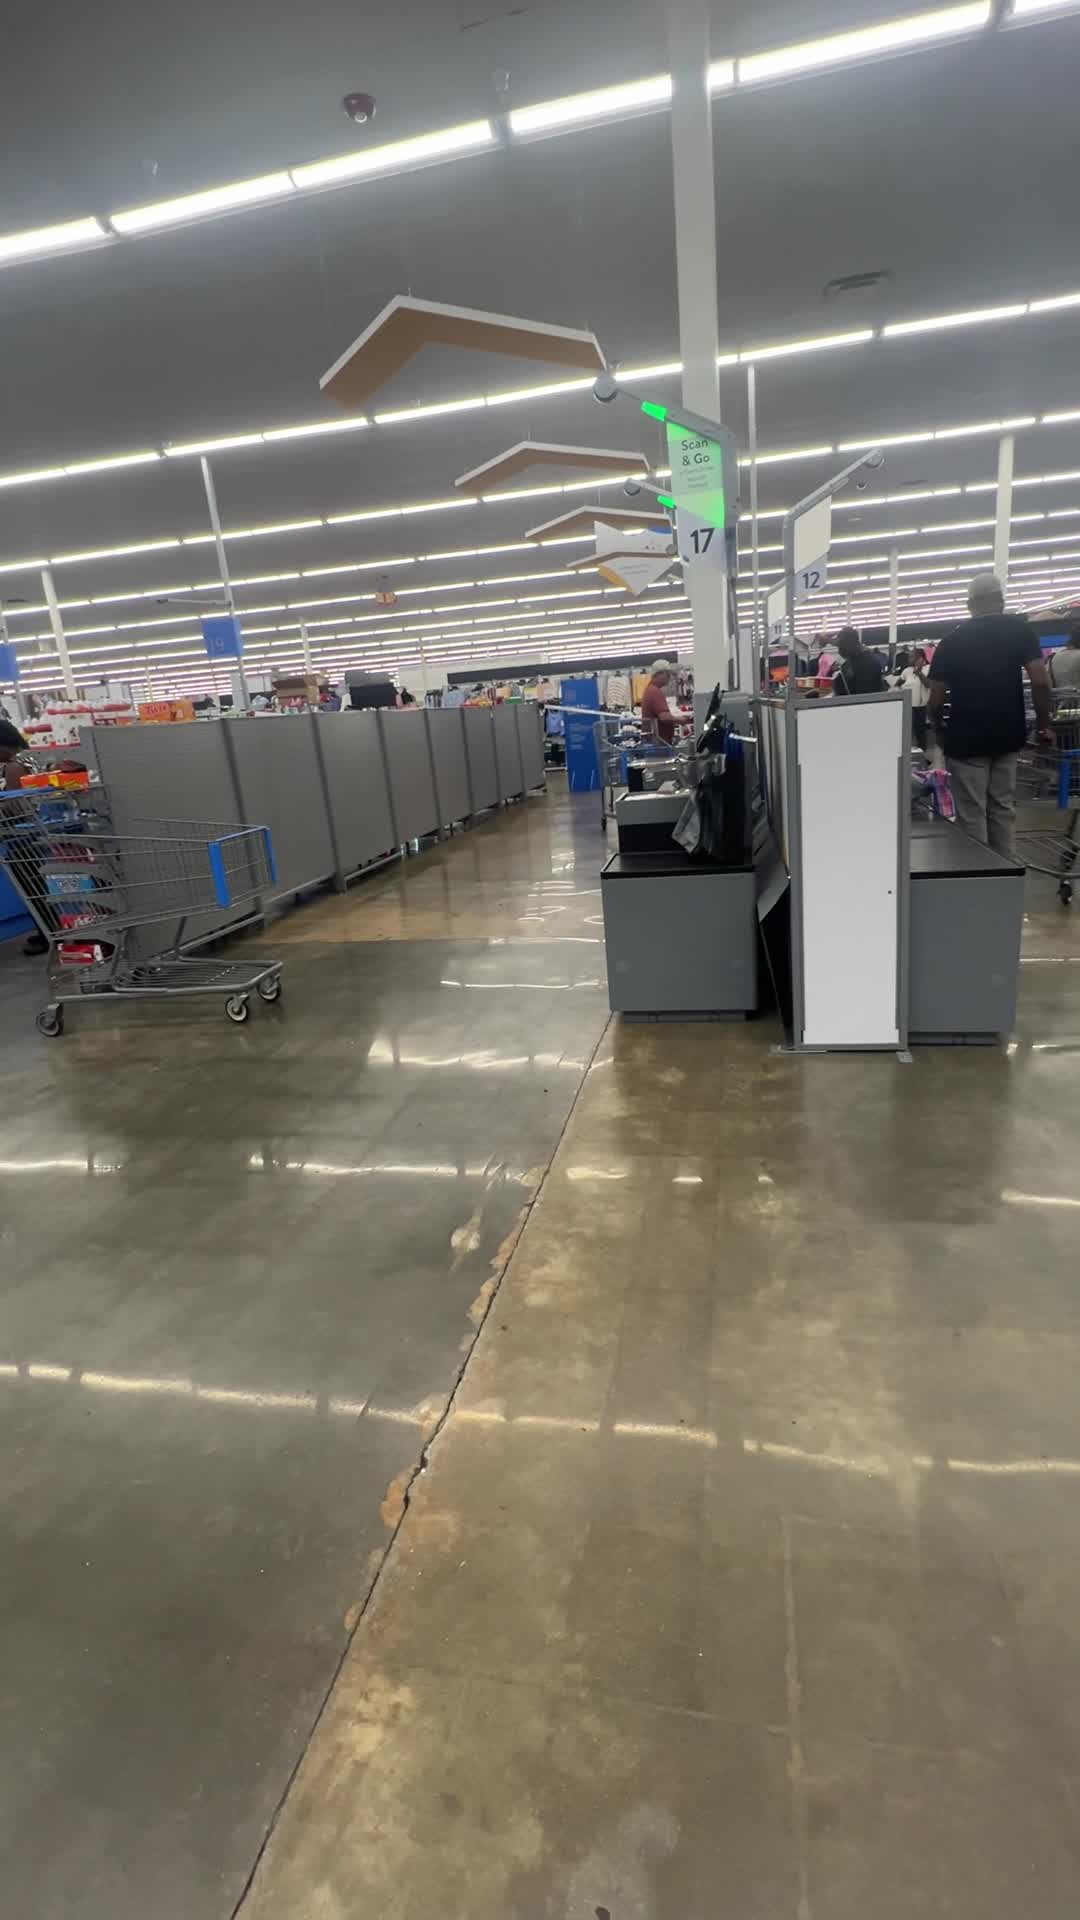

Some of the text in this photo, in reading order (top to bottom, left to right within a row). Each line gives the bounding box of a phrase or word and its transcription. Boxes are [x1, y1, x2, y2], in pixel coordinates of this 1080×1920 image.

[681, 440, 709, 451] Scan
[682, 453, 710, 466] & Go
[690, 527, 715, 554] 17
[802, 571, 820, 590] 12
